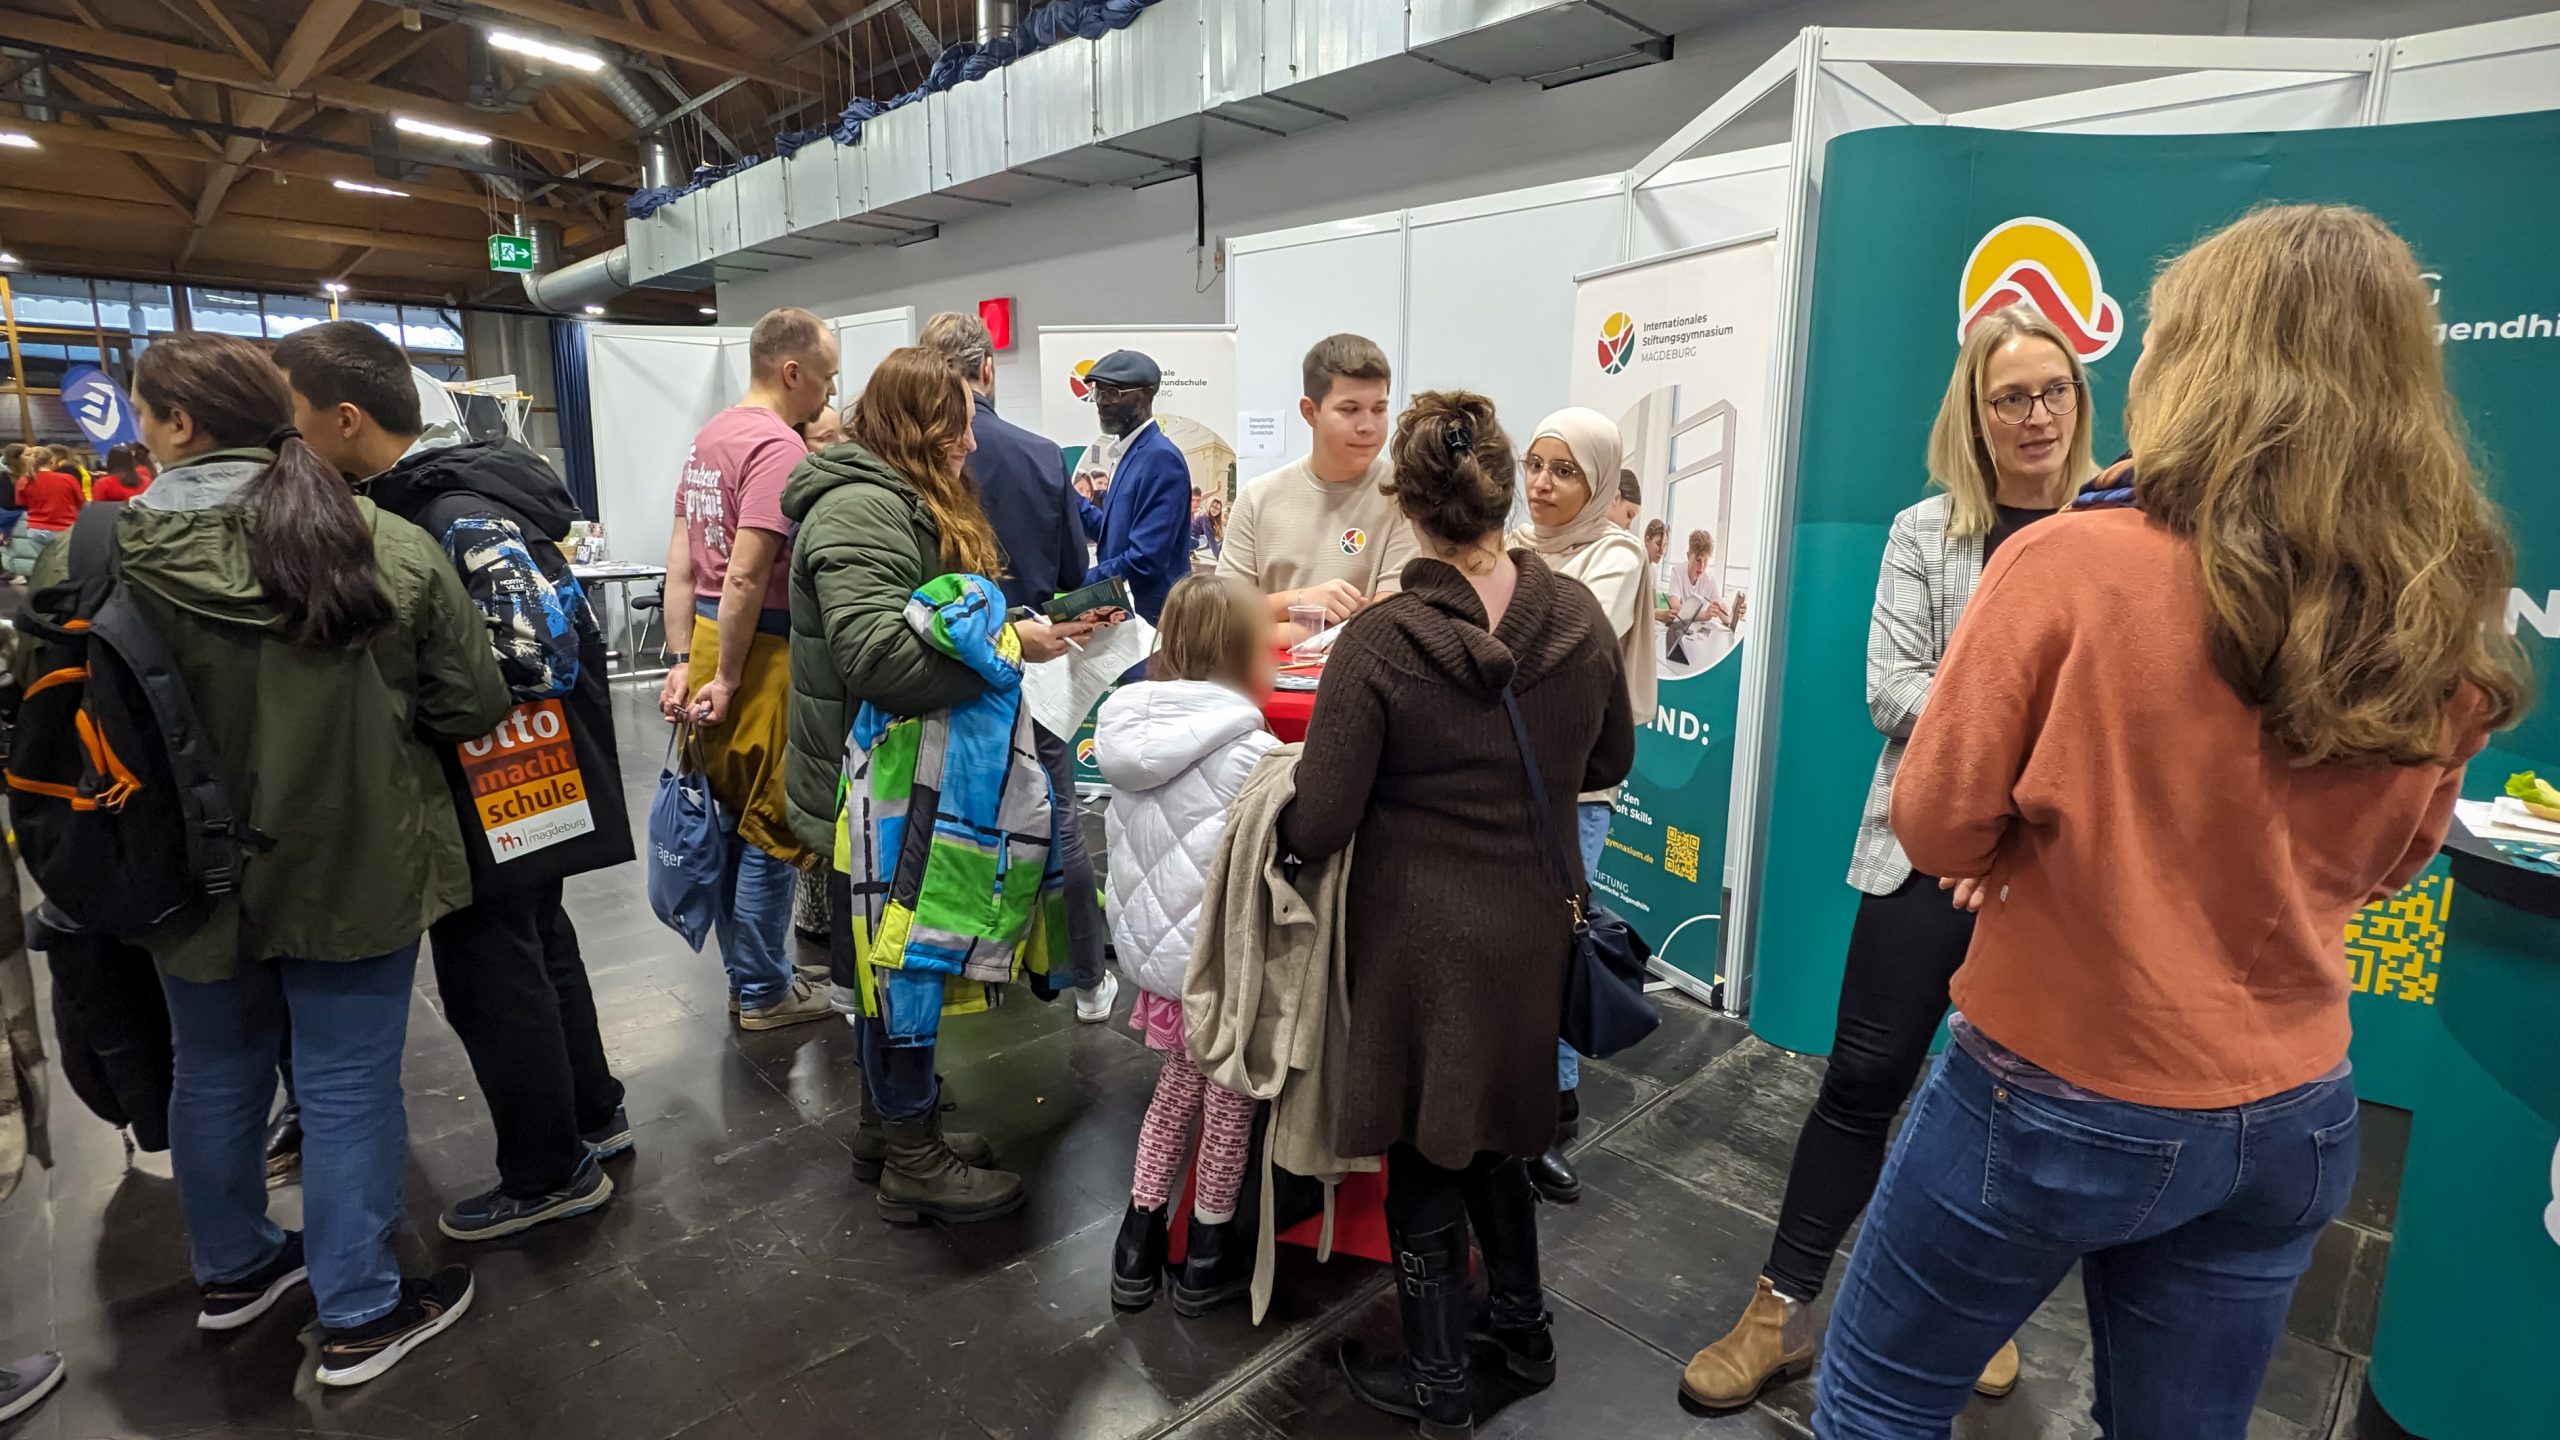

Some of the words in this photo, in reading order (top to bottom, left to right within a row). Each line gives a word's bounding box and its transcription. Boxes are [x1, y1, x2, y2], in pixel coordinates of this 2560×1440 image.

[1643, 313, 1708, 332] Internationales
[1642, 325, 1734, 346] Stiftungsgymnasium
[1641, 346, 1697, 362] MAGDEBURG
[1646, 704, 1710, 746] ND:
[476, 747, 571, 794] macht
[486, 779, 578, 825] schule
[1623, 791, 1640, 806] den
[1629, 807, 1653, 826] Skills
[528, 817, 587, 844] magdeburg
